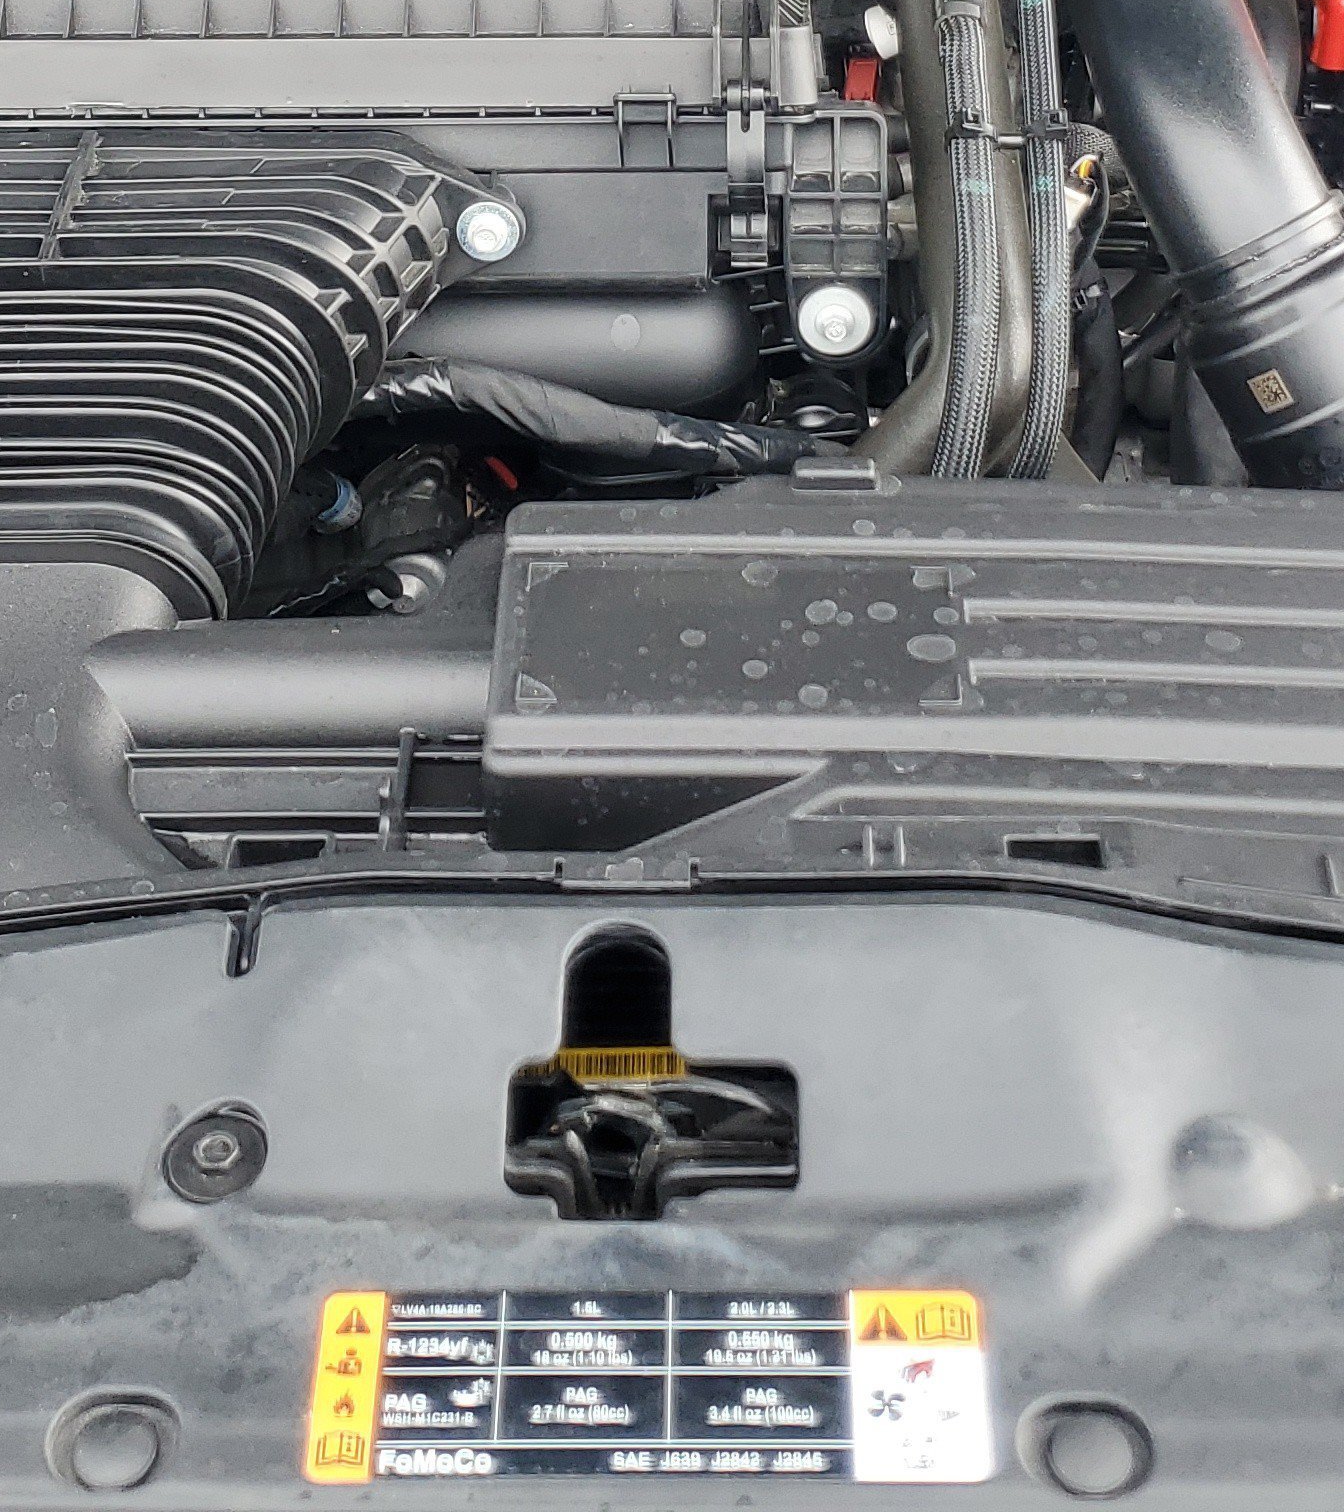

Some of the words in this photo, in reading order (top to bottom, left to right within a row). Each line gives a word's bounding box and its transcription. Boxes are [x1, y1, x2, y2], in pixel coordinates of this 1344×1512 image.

[730, 1301, 757, 1315] 2.0L
[759, 1300, 765, 1315] /
[387, 1336, 469, 1358] R-1234yf
[550, 1332, 594, 1349] 0.500
[597, 1332, 617, 1352] kg
[727, 1331, 770, 1348] 0.550
[773, 1331, 794, 1351] kg
[552, 1352, 570, 1365] oz
[608, 1349, 633, 1366] lbs)
[736, 1351, 754, 1364] oz
[791, 1349, 816, 1366] lbs)
[384, 1393, 427, 1412] PAG
[565, 1386, 598, 1403] PAG
[745, 1387, 778, 1404] PAG
[531, 1404, 553, 1420] 2.7
[556, 1404, 565, 1420] fl
[568, 1406, 585, 1419] oz
[587, 1403, 630, 1424] (80cc)
[709, 1405, 731, 1421] 3.4
[733, 1405, 742, 1421] fl
[745, 1408, 763, 1420] oz
[764, 1405, 814, 1426] (100cc)
[378, 1447, 493, 1474] FoMoCo
[612, 1451, 651, 1467] SAE
[658, 1450, 702, 1468] J639
